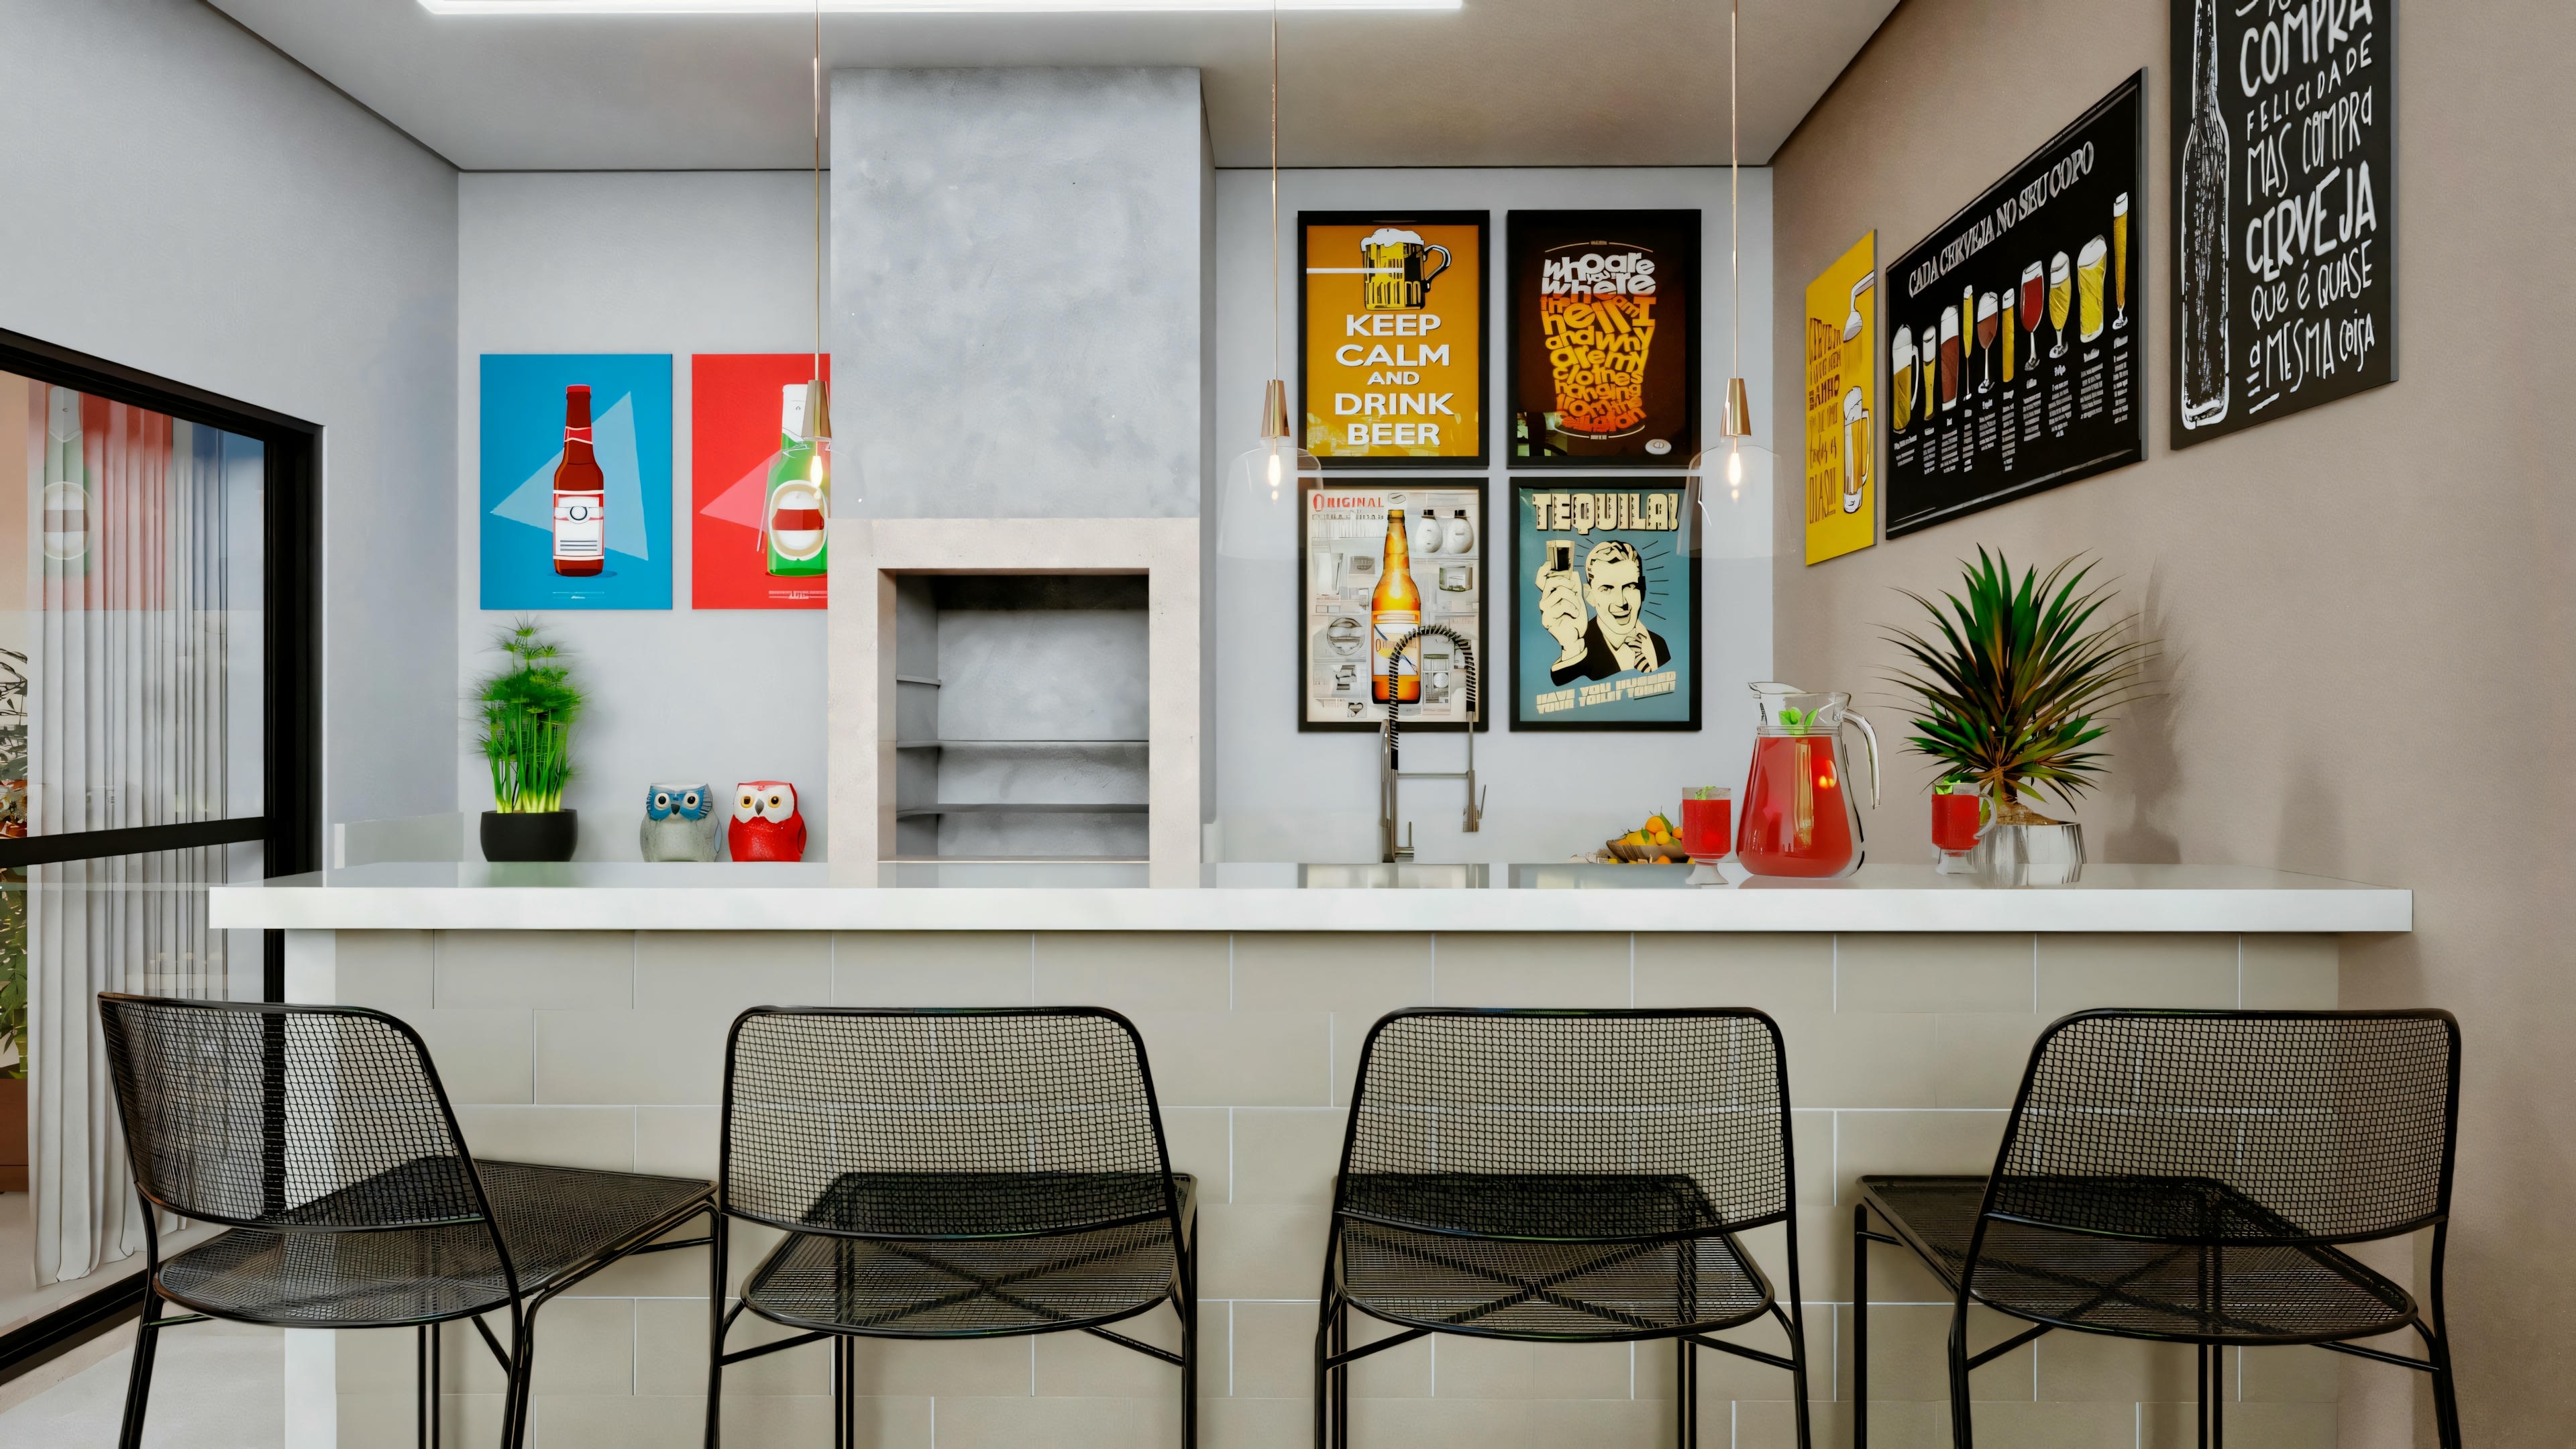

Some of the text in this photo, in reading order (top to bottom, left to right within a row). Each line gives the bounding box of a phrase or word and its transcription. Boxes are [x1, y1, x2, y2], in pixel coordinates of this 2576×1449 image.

[2247, 32, 2372, 141] FELICIDADE
[2247, 123, 2292, 205] MAS
[1909, 141, 2094, 298] CADA CERVEJA NO SEU COPO
[2246, 160, 2377, 282] CERVEJA
[1544, 252, 1656, 282] who are
[2318, 239, 2372, 309] QUASE
[1542, 273, 1656, 303] where
[1346, 314, 1442, 336] KEEP
[1541, 301, 1632, 335] hell
[1546, 325, 1655, 352] and why
[1336, 344, 1450, 366] CALM
[1550, 345, 1649, 372] are my
[2265, 317, 2334, 392] MESMA
[1367, 371, 1420, 385] AND
[1552, 364, 1644, 386] clothes
[1335, 392, 1454, 415] DRINK
[1554, 380, 1642, 402] hanging
[1348, 423, 1441, 445] BEER
[1532, 493, 1679, 535] TEQUILA!
